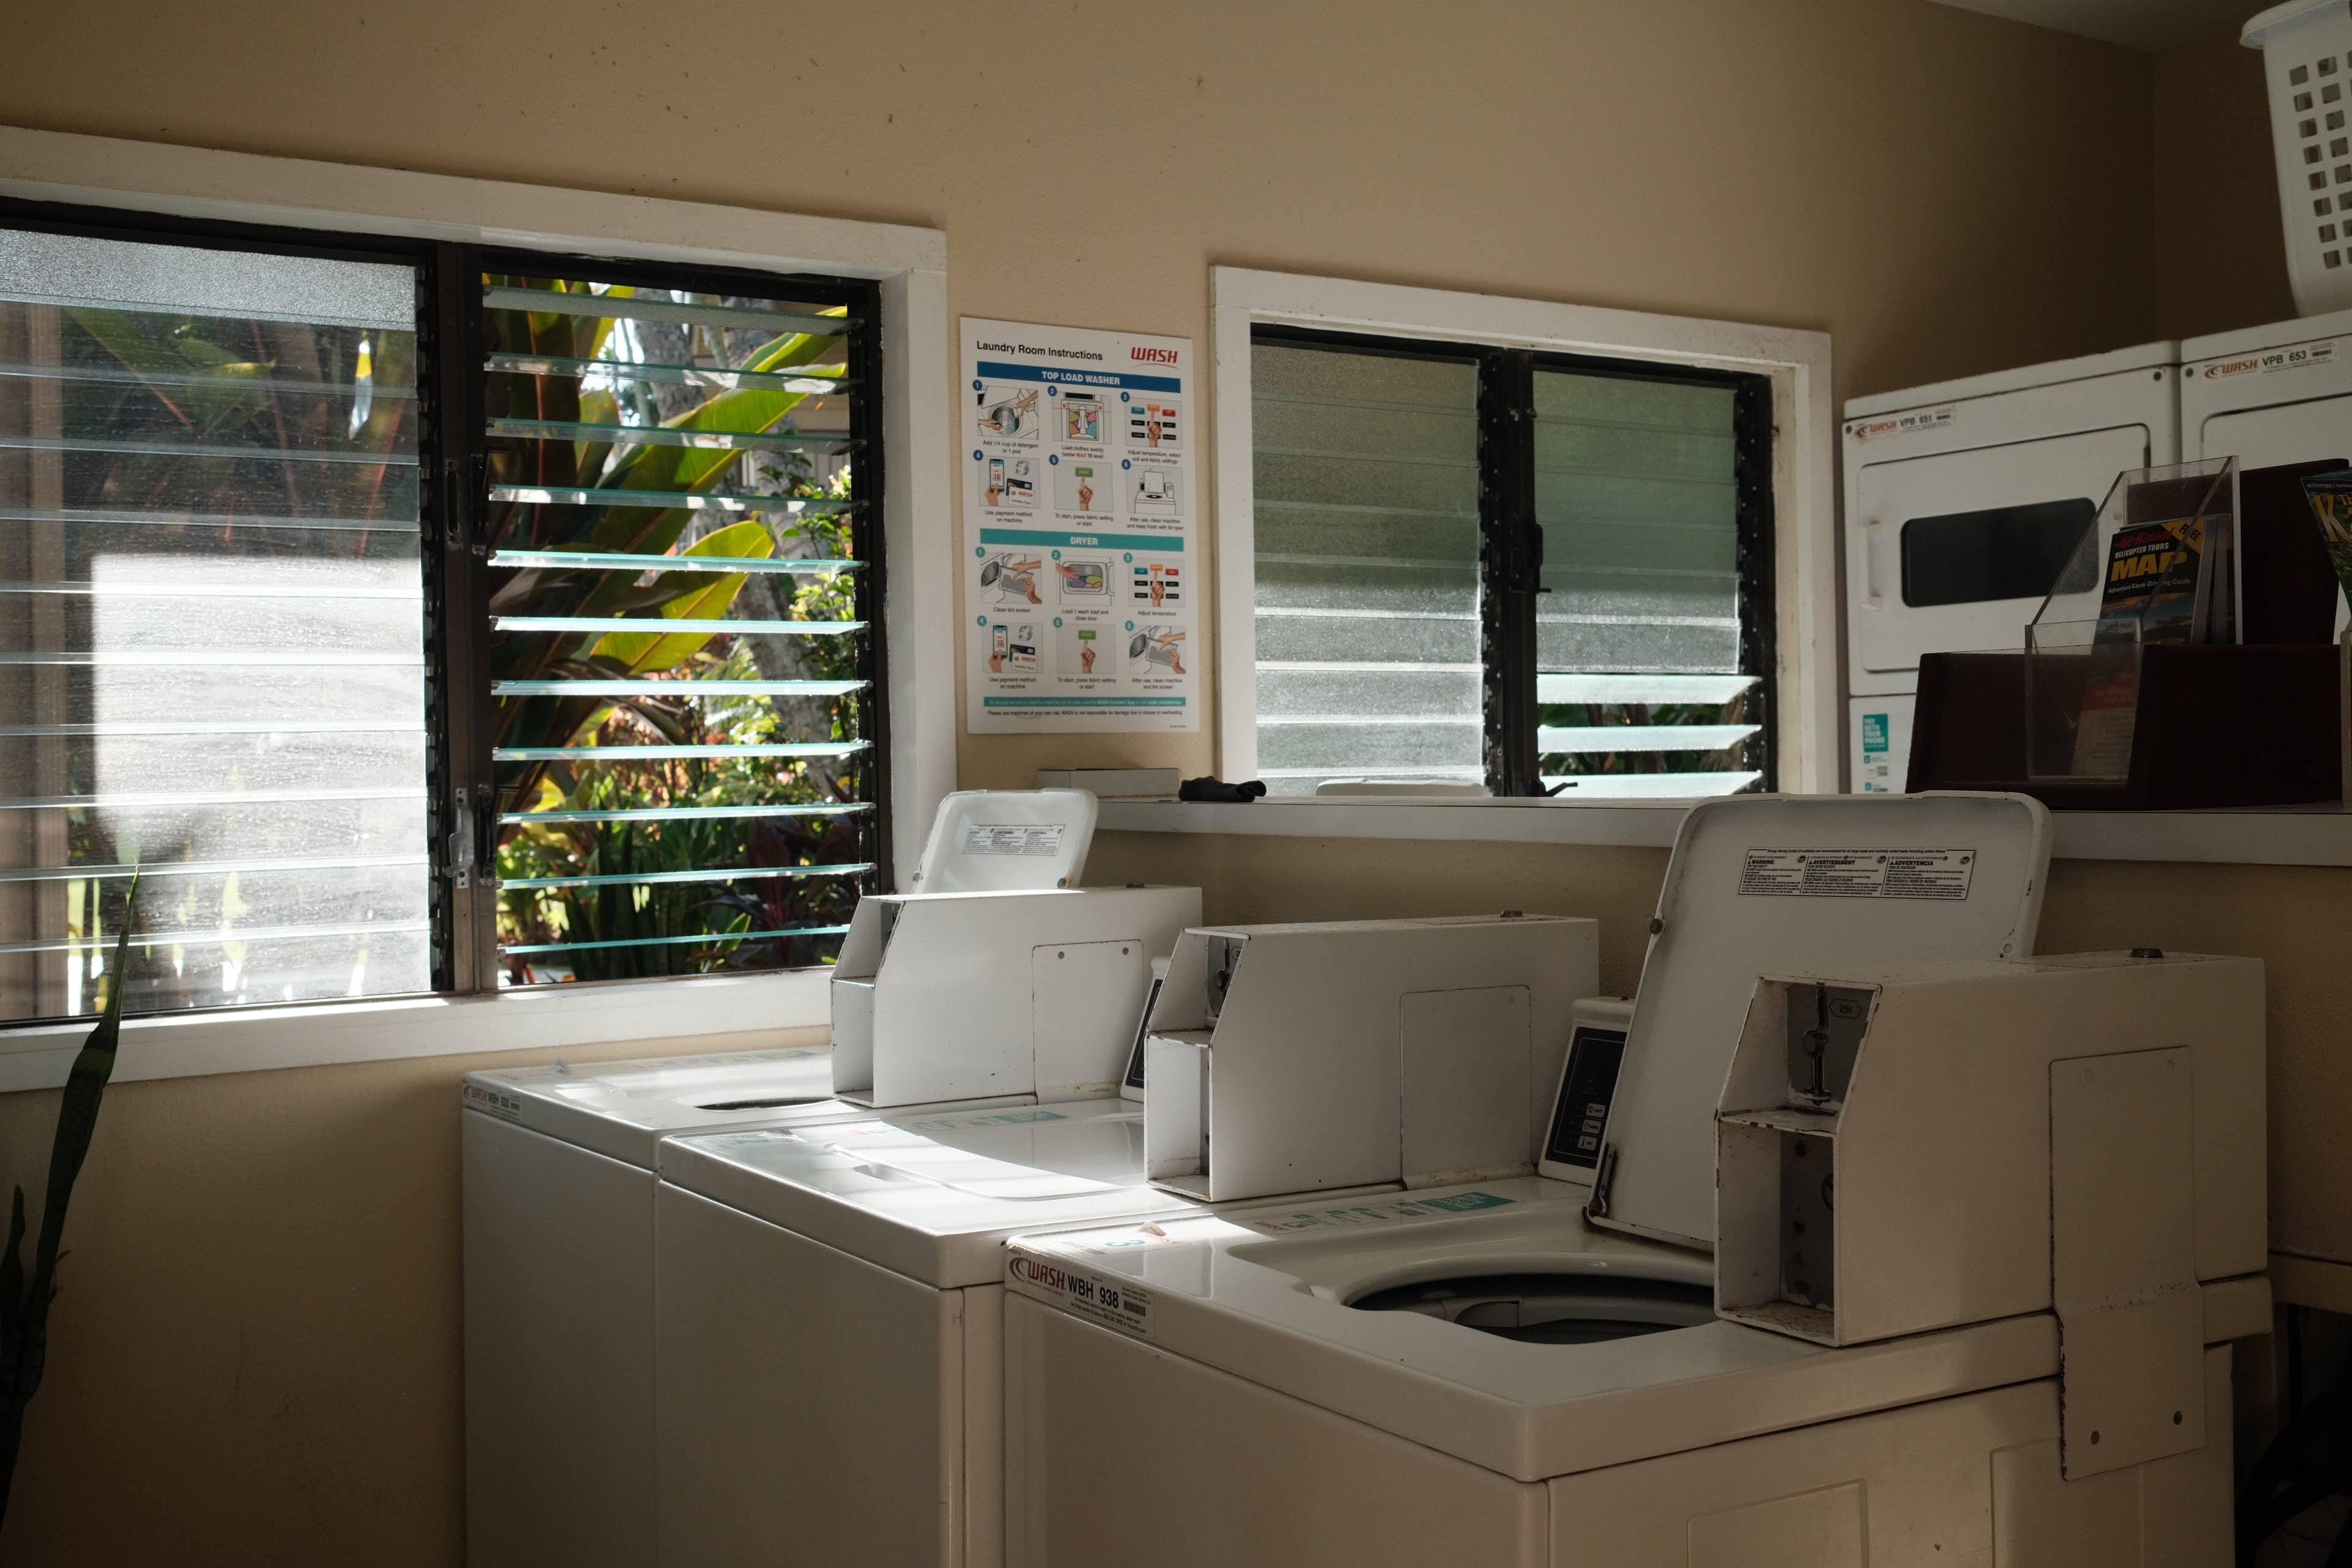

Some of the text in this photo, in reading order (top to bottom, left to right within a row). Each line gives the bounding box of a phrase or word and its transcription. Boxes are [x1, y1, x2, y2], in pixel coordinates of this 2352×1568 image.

[976, 341, 1102, 360] Laundry Room Instructions
[1131, 347, 1178, 363] WASH
[2222, 360, 2258, 374] WASH
[2263, 355, 2283, 366] VPB
[2289, 350, 2307, 361] 653
[1042, 371, 1120, 385] TOP LOAD WASHER
[1899, 417, 1915, 427] VPB
[1012, 447, 1021, 456] pod
[1017, 441, 1038, 450] detergent
[1070, 537, 1098, 546] DRYER
[2136, 527, 2176, 545] Kauai
[2114, 542, 2169, 559] HELICOPTER TOURS
[2111, 551, 2187, 582] MAP
[2108, 584, 2132, 594] Adventure
[1027, 1260, 1065, 1291] WASH
[1068, 1274, 1093, 1300] WBH
[1099, 1286, 1119, 1309] 938
